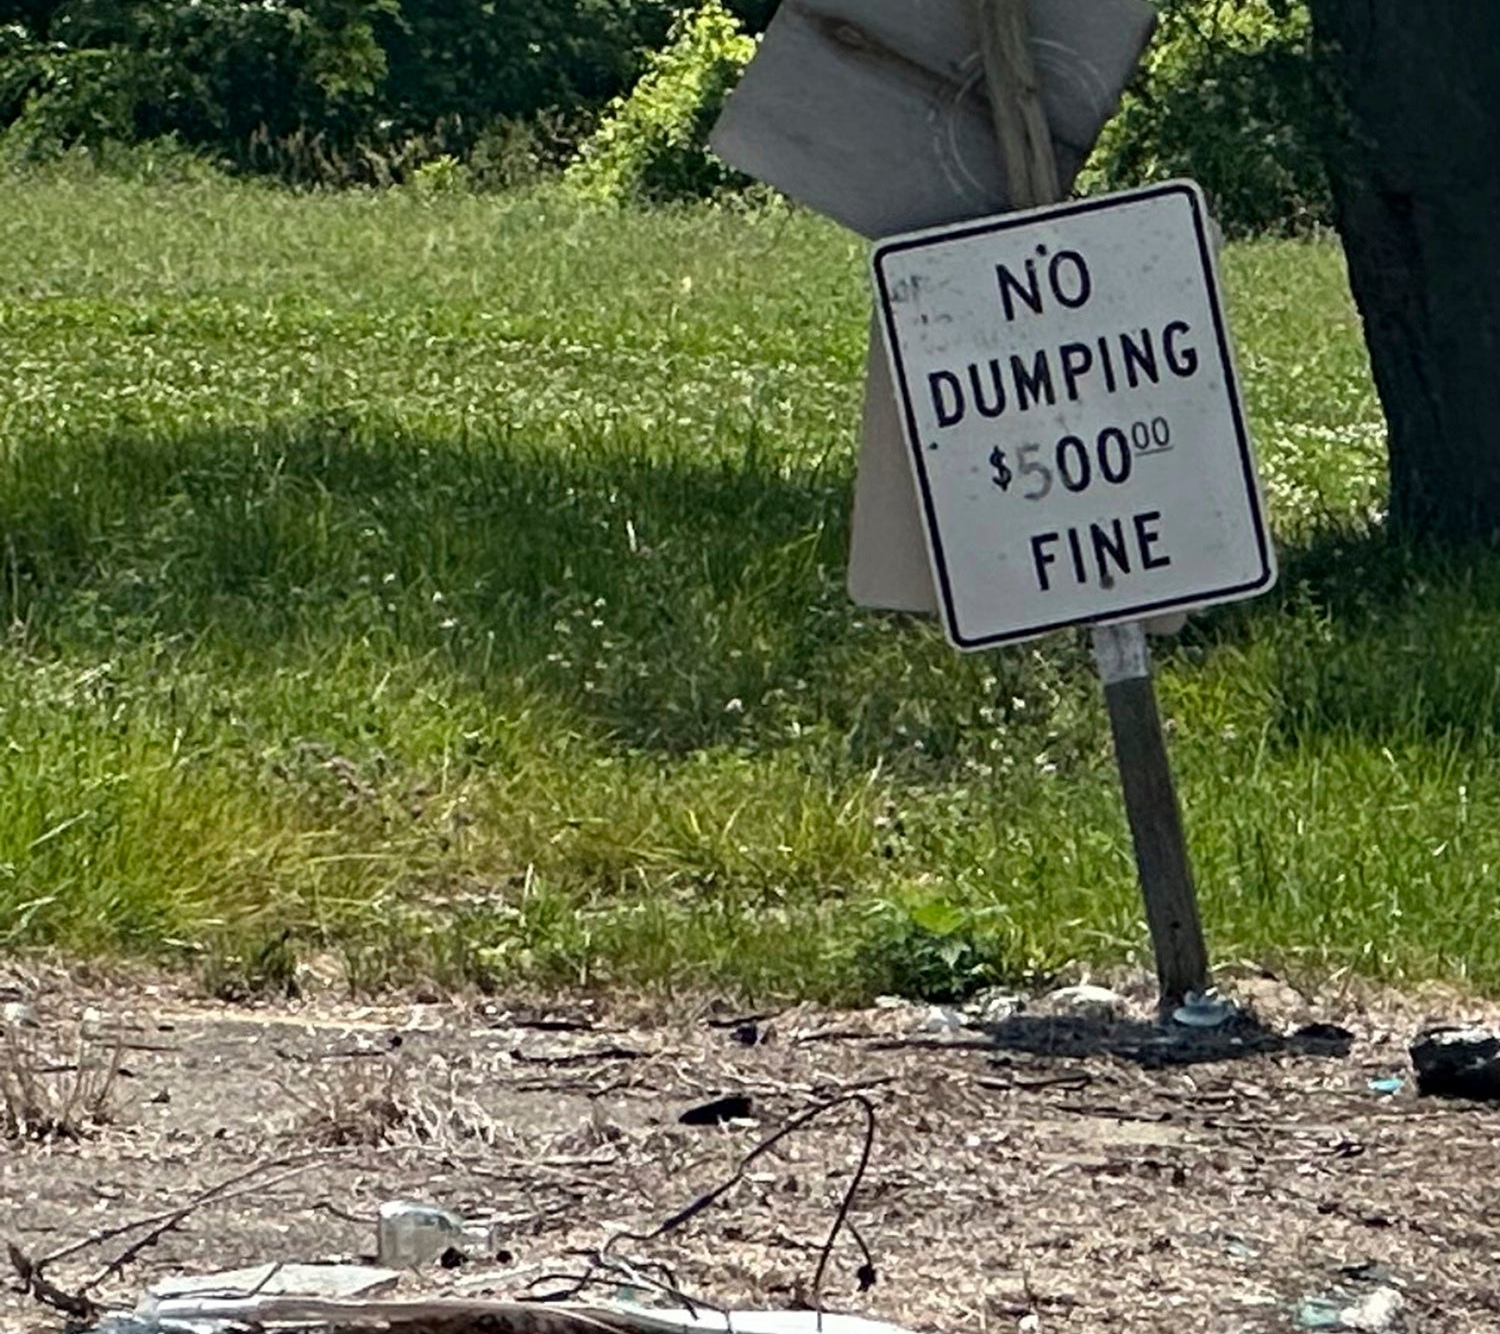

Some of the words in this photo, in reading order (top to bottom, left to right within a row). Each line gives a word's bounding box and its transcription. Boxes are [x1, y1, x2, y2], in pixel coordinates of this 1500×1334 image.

[995, 250, 1091, 322] NO
[927, 320, 1199, 429] DUMPING
[1030, 510, 1171, 592] FINE
